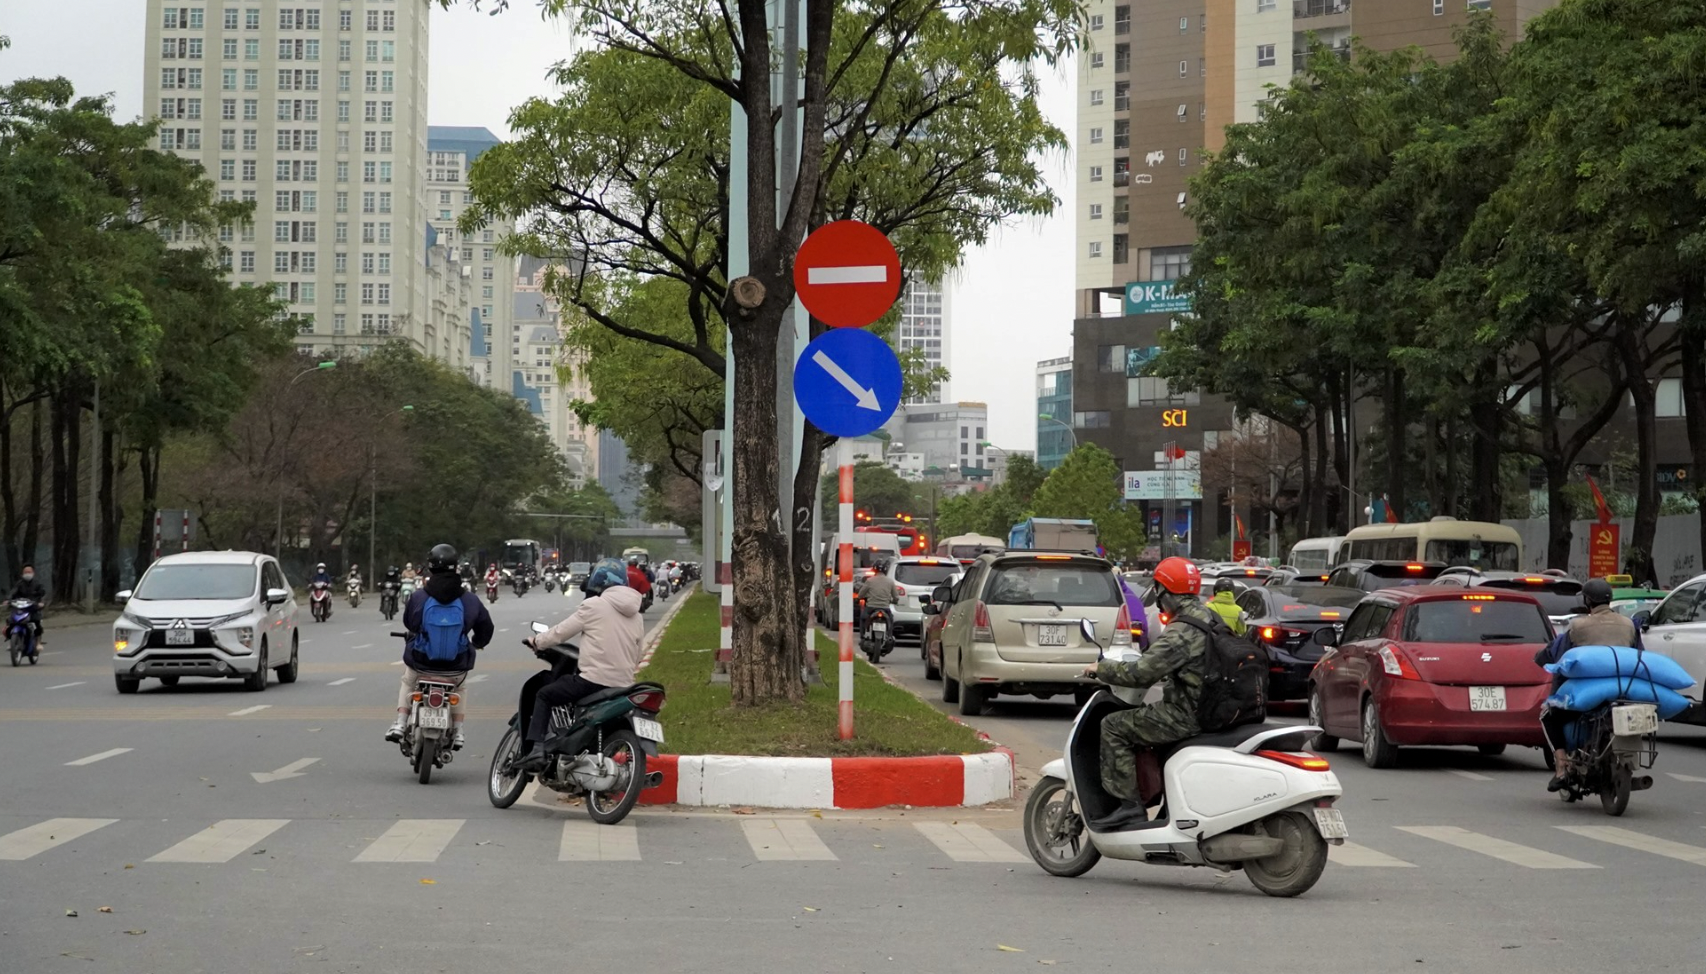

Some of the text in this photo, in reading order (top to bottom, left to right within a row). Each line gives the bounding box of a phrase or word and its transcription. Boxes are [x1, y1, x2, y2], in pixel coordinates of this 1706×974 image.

[1163, 409, 1187, 427] SCI
[1128, 476, 1140, 489] ila
[772, 506, 810, 534] 1 2
[1046, 624, 1060, 635] 30F
[1040, 634, 1066, 644] 731.40
[1478, 686, 1496, 698] 30E
[1471, 698, 1504, 710] 574.87
[421, 717, 446, 728] 369.50
[1253, 792, 1277, 802] KLARA
